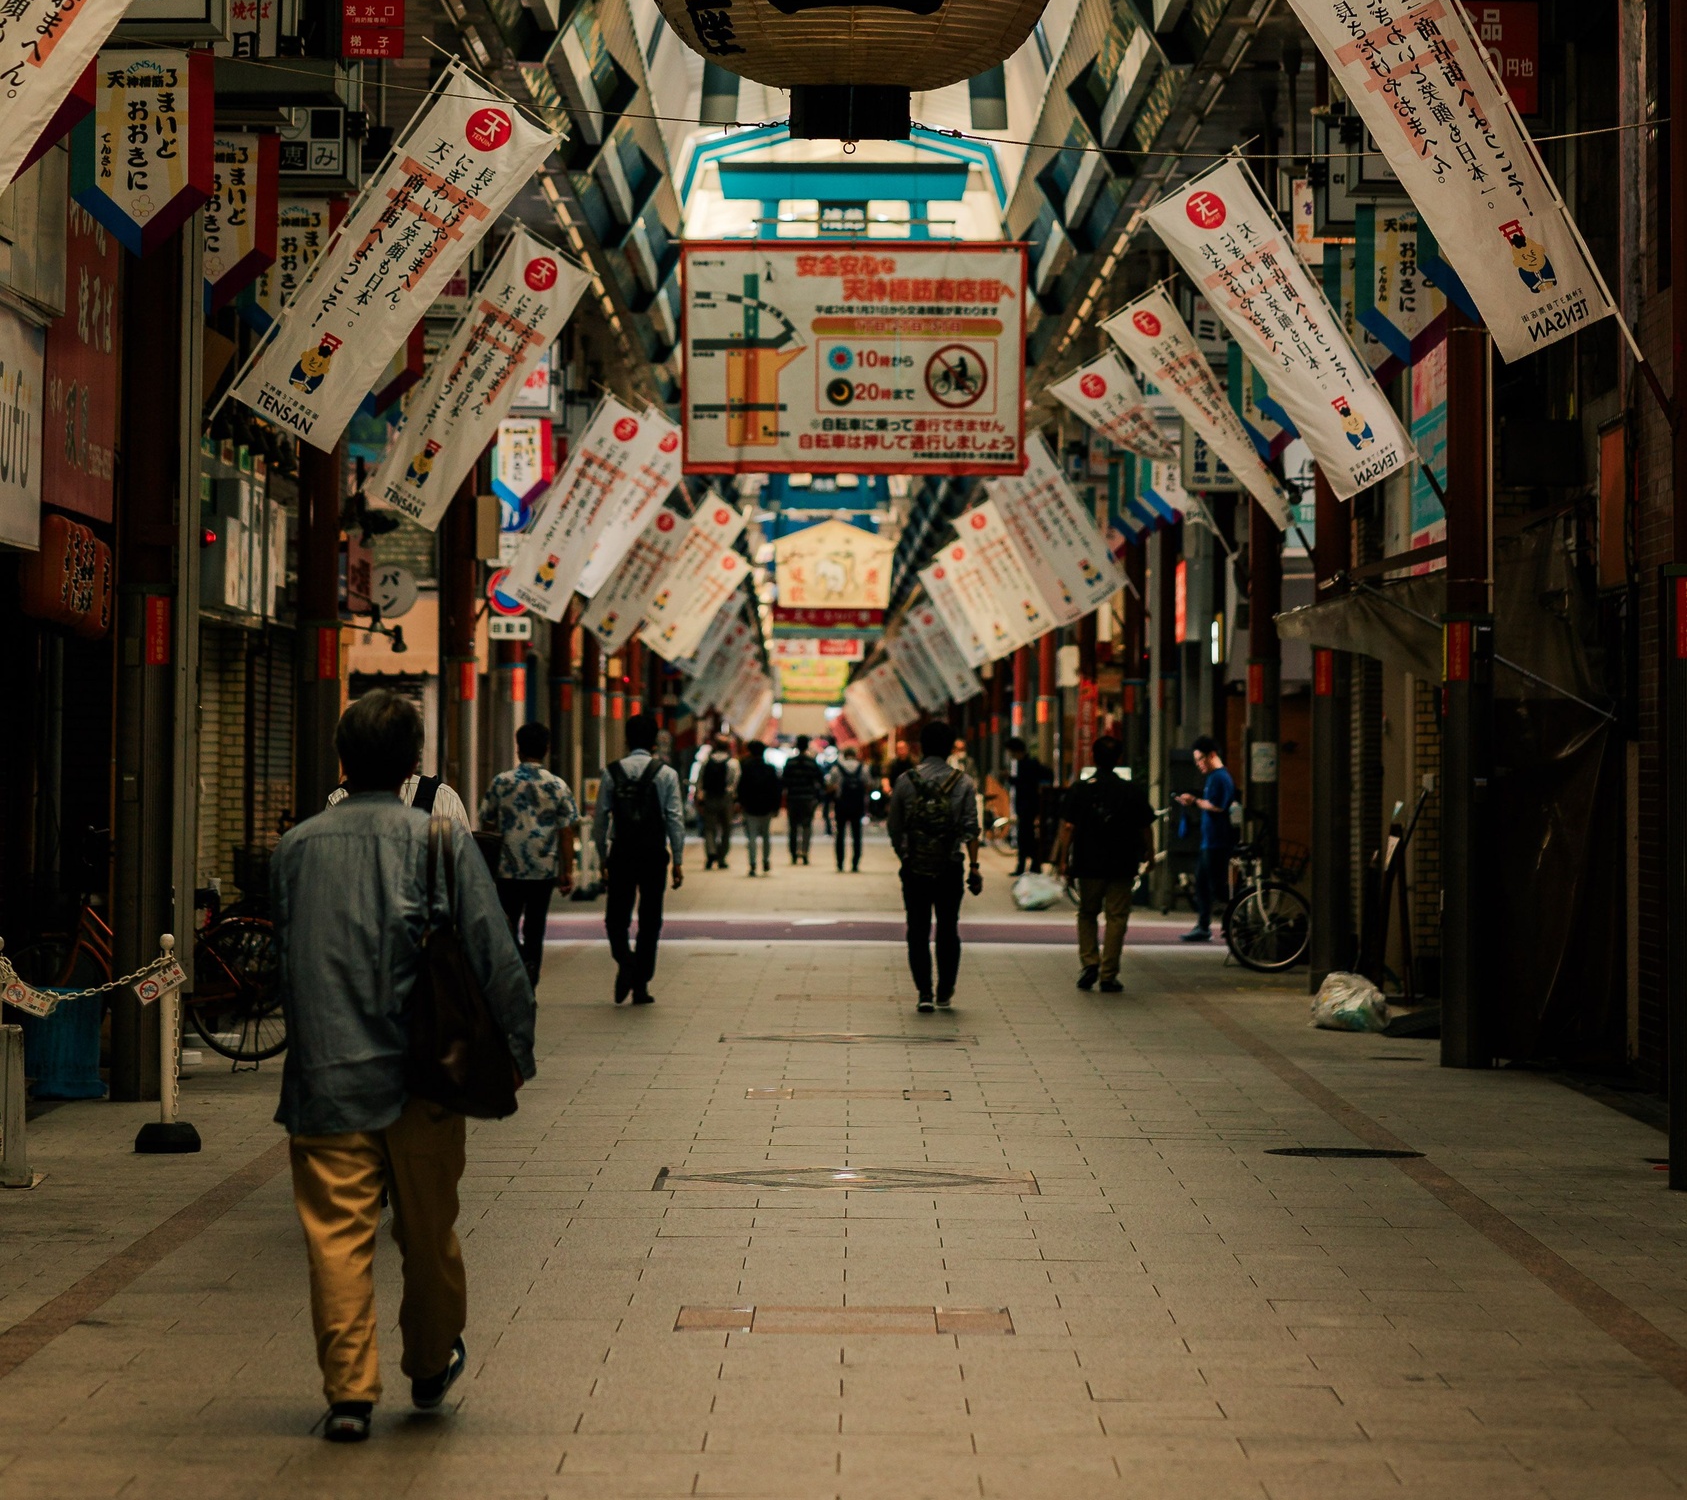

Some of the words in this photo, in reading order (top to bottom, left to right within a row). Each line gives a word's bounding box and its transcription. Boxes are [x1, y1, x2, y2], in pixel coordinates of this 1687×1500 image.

[346, 5, 394, 16] 送水口
[350, 35, 390, 47] 梯子
[126, 60, 165, 74] TENSAN
[101, 133, 111, 177] てんさん
[127, 100, 148, 190] おおきに
[156, 93, 177, 159] まいど
[228, 167, 247, 226] まいど
[311, 137, 454, 328] 天三商店街へようこそ！
[346, 153, 474, 328] にぎわいと笑顔も日本一。
[385, 167, 496, 311] 長さだけやおまへん。
[1399, 241, 1416, 312] おおきに
[257, 390, 313, 435] TENSAN
